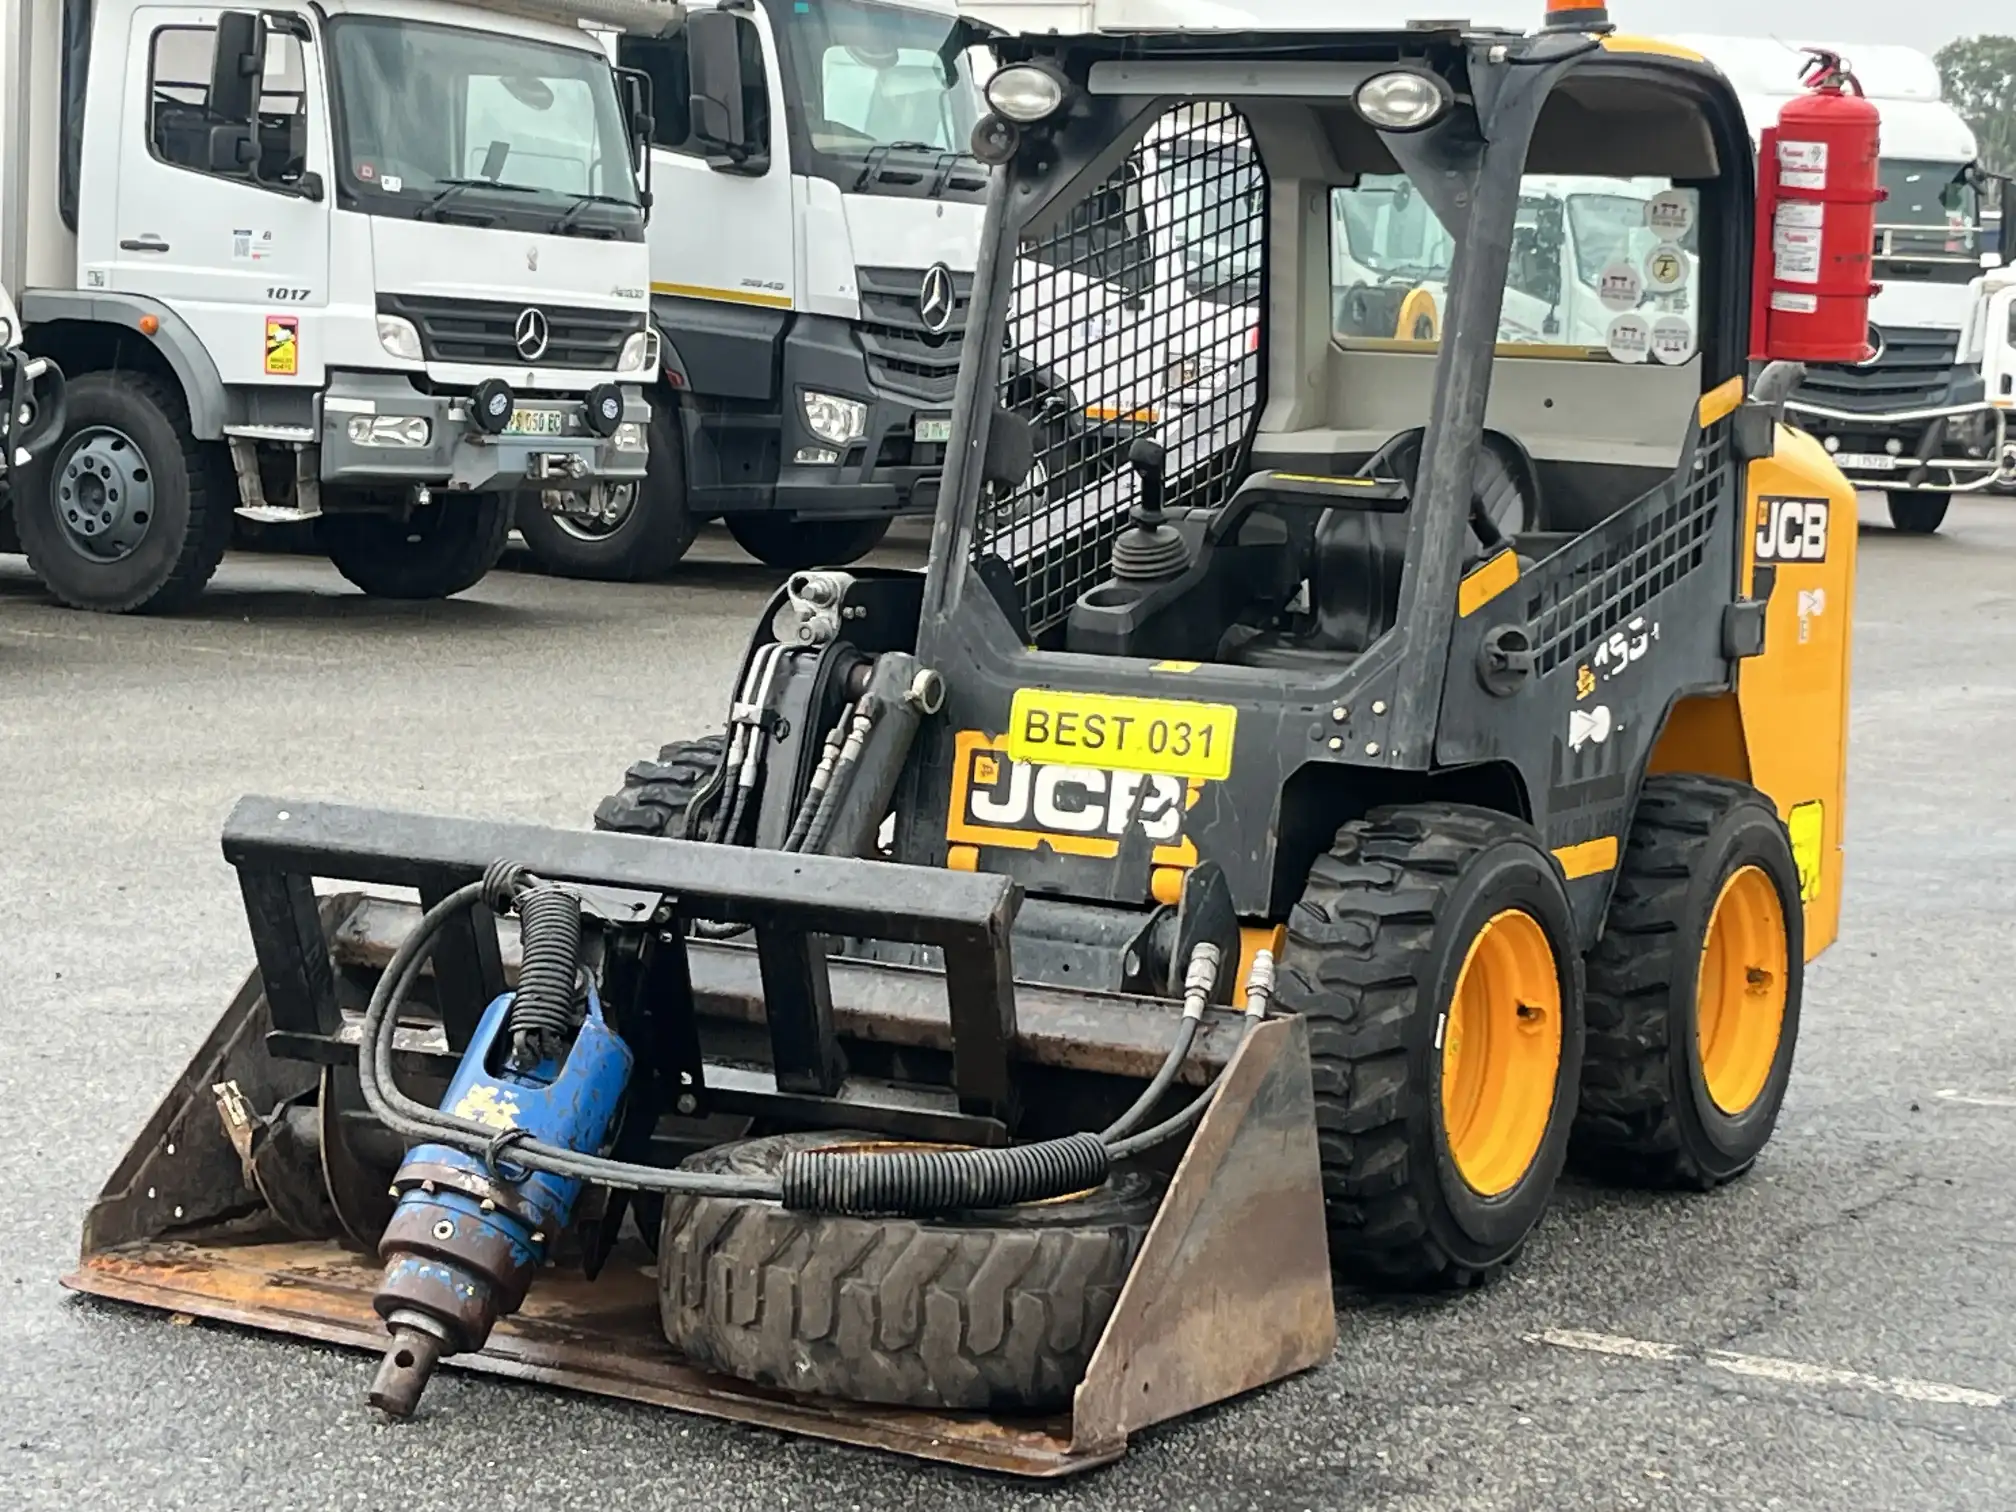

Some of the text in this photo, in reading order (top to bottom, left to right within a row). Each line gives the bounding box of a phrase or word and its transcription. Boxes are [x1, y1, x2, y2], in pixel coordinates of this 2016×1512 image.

[266, 287, 311, 300] 1017
[524, 412, 545, 432] 050
[548, 412, 561, 432] EC
[1755, 501, 1828, 559] JCB
[1024, 708, 1215, 759] BEST 031
[971, 762, 1181, 839] JCB
